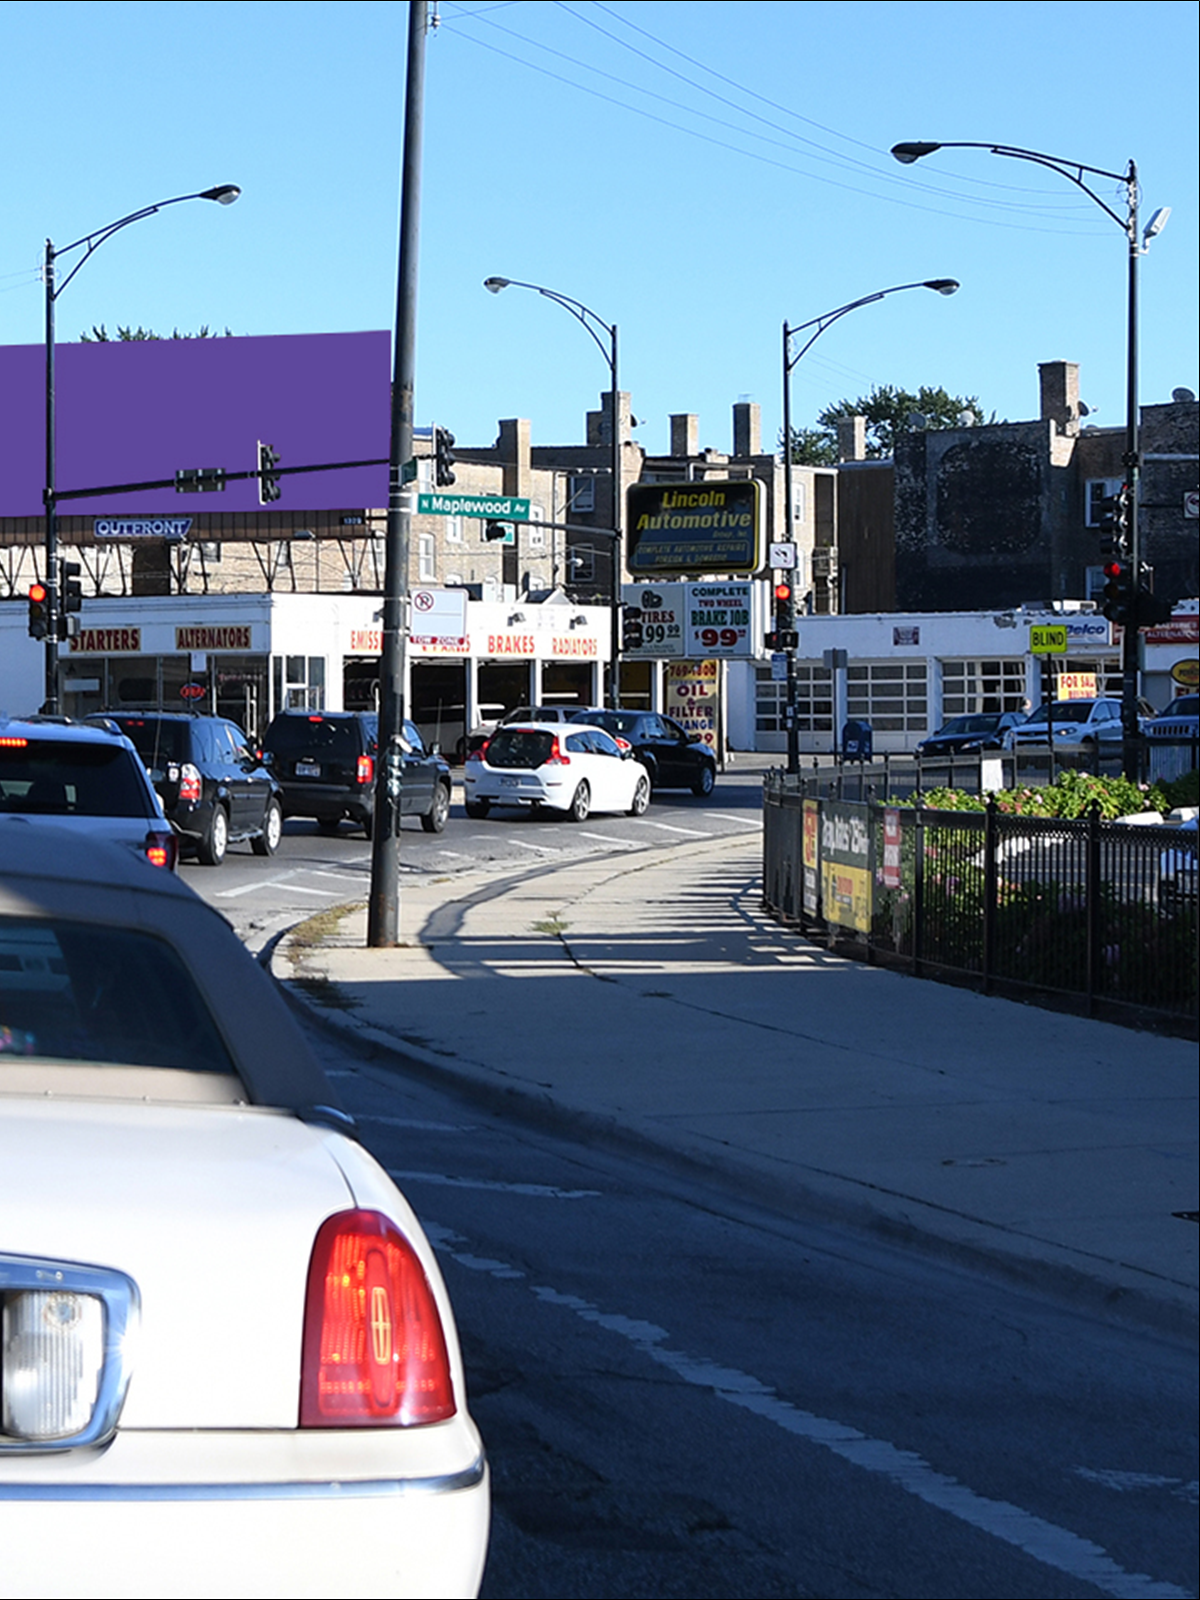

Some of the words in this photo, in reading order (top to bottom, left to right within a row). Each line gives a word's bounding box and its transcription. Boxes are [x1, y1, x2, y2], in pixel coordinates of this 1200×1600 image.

[422, 500, 429, 508] N
[432, 496, 511, 514] Maplewood
[662, 491, 725, 508] Lincoln
[97, 520, 187, 535] OUTFRONT
[636, 511, 751, 530] Automotive
[692, 587, 748, 597] COMPLETE
[641, 610, 675, 623] TIRES
[691, 610, 728, 626] BRAKE
[730, 609, 749, 626] JOB
[1066, 623, 1105, 635] Delco
[71, 630, 140, 651] STARTERS
[177, 628, 250, 649] ALTERNATORS
[488, 635, 535, 653] BRAKES
[552, 637, 597, 655] RADIATORS
[1032, 632, 1064, 646] BLIND
[1060, 675, 1078, 688] FOR
[676, 685, 709, 698] OIL
[669, 706, 714, 718] FILTER
[679, 719, 714, 730] ANGE
